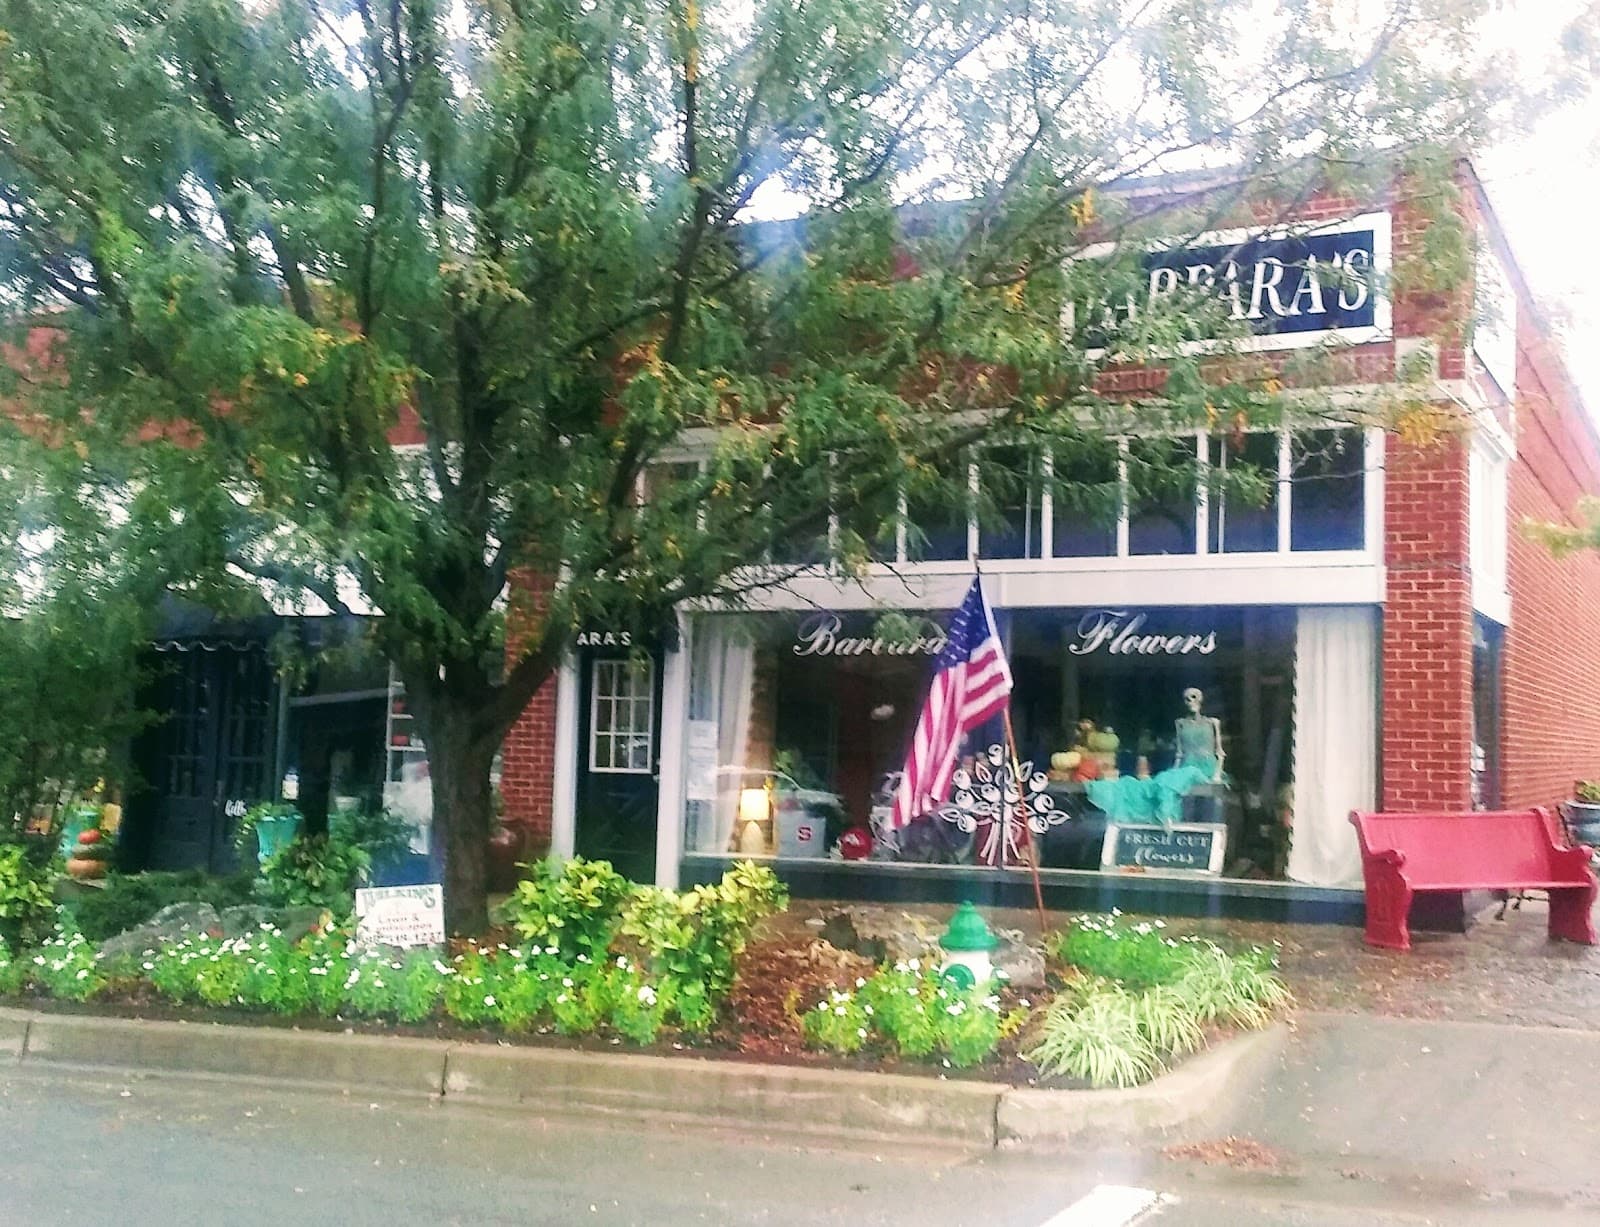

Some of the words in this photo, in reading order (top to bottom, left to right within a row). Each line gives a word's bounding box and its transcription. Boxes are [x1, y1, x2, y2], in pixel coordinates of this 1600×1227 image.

[1068, 609, 1217, 655] Flowers
[797, 826, 812, 841] S
[1124, 832, 1172, 846] FRESH
[1176, 835, 1209, 848] CUT
